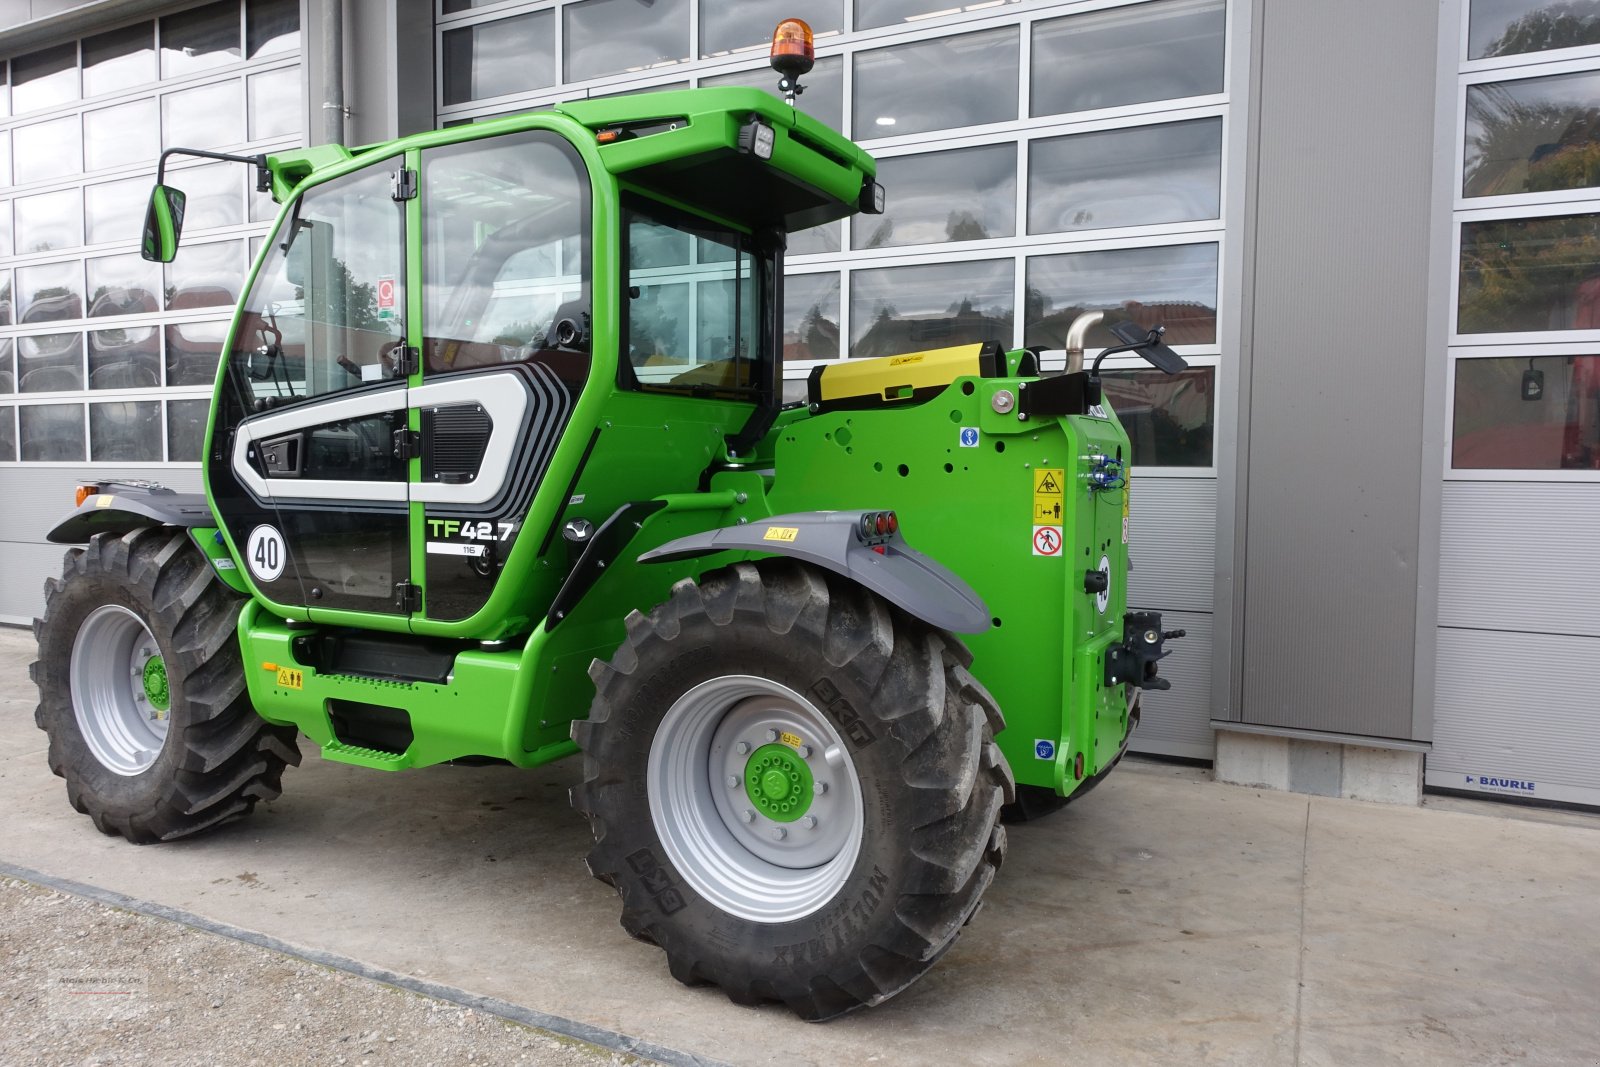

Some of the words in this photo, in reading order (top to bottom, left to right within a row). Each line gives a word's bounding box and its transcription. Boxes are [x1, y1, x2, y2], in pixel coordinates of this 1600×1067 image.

[427, 519, 514, 541] TF42.7
[255, 536, 278, 570] 40
[463, 546, 476, 554] 116
[811, 677, 877, 750] BKT
[625, 847, 688, 916] BKT
